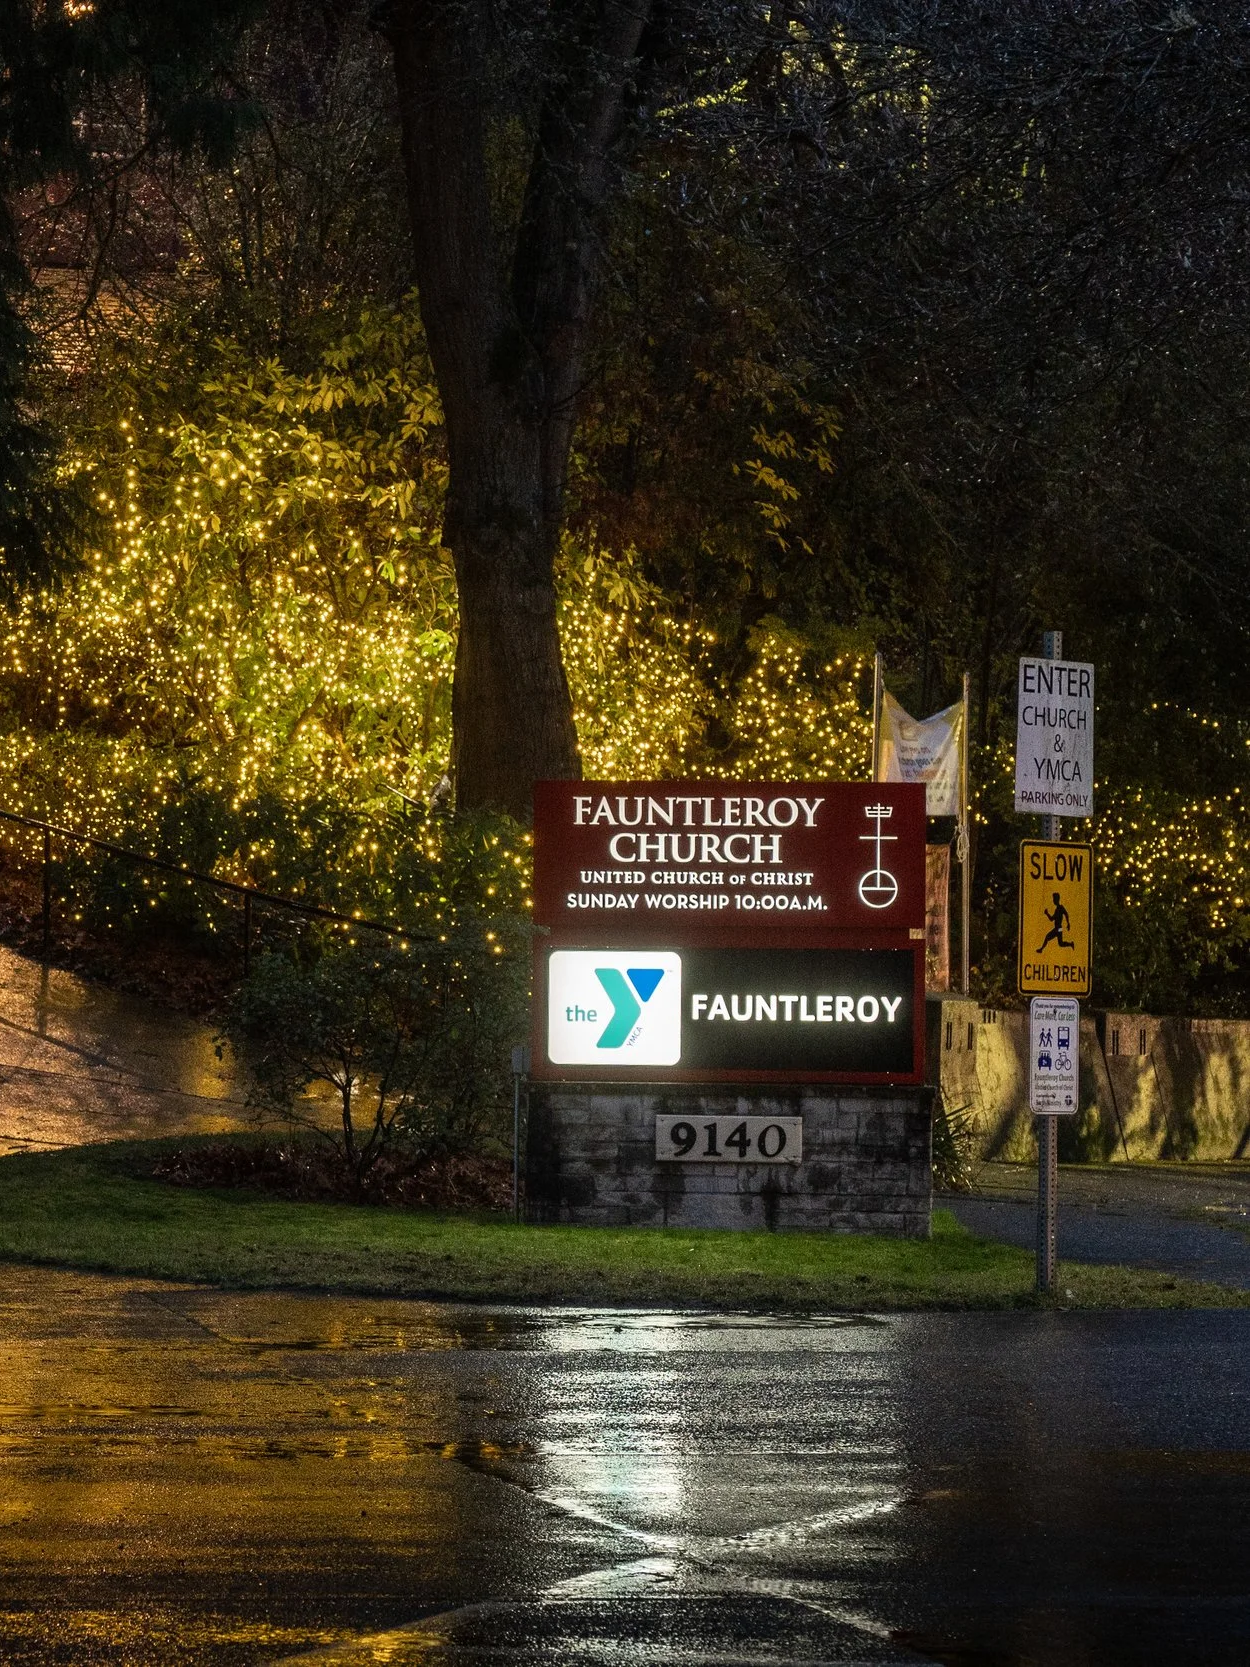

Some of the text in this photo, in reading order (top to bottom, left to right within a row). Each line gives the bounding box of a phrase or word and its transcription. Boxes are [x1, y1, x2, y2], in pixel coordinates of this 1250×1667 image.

[1023, 664, 1091, 698] ENTER
[1022, 706, 1087, 730] CHURCH
[1053, 735, 1064, 753] &
[1034, 757, 1082, 782] YMCA
[1021, 790, 1089, 808] PARKING ONLY
[572, 796, 825, 828] FAUNTLEROY
[609, 833, 784, 864] CHURCH
[580, 871, 645, 885] UNITED
[651, 871, 724, 885] CHURCH
[750, 872, 814, 886] CHRIST
[1030, 852, 1083, 882] SLOW
[567, 894, 640, 909] SUNDAY
[644, 894, 730, 910] WORSHIP
[1024, 964, 1086, 983] CHILDREN
[566, 1005, 598, 1022] the
[691, 994, 902, 1023] FAUNTLEROY
[626, 1026, 643, 1047] YMCA
[670, 1121, 787, 1158] 9140
